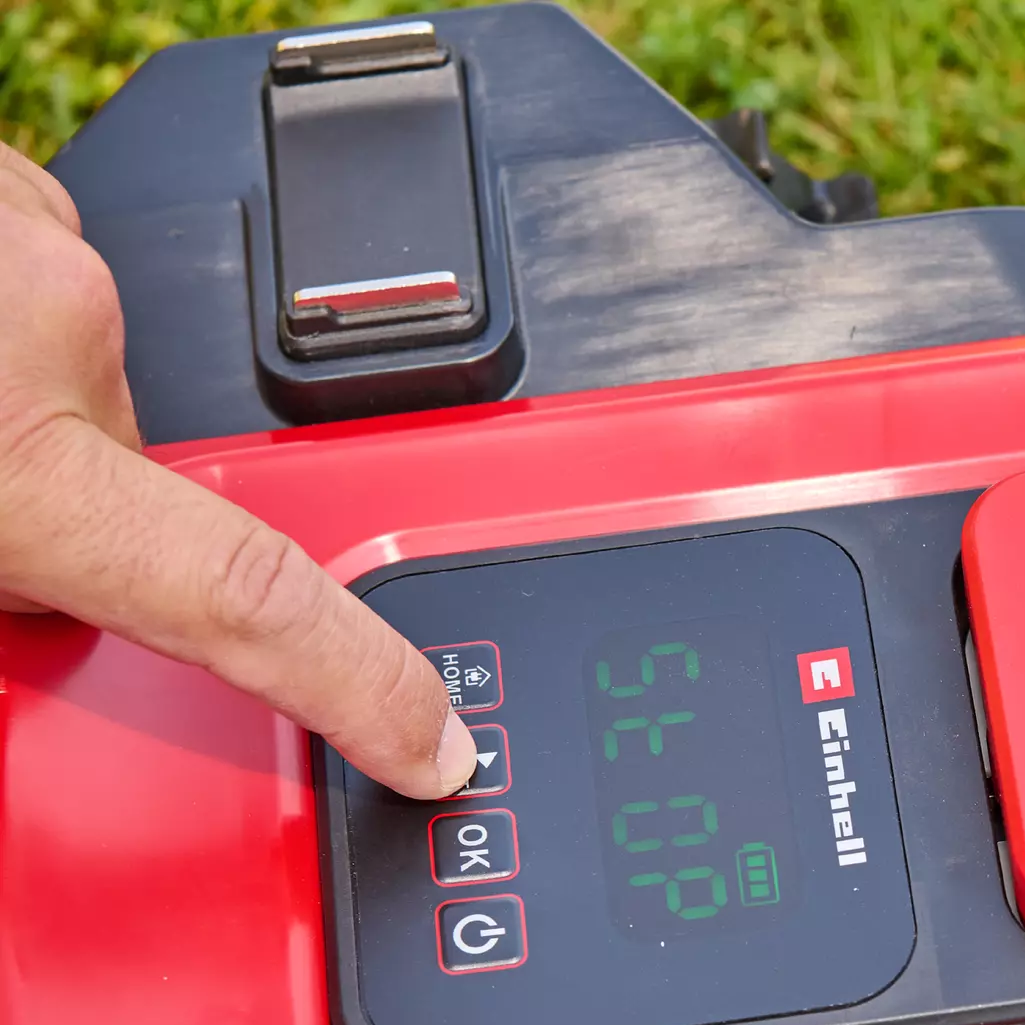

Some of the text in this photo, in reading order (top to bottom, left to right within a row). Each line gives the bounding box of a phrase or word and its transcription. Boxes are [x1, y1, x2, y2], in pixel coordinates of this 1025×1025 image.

[442, 653, 463, 706] HOME
[817, 707, 868, 867] Einhell
[457, 824, 491, 872] OK
